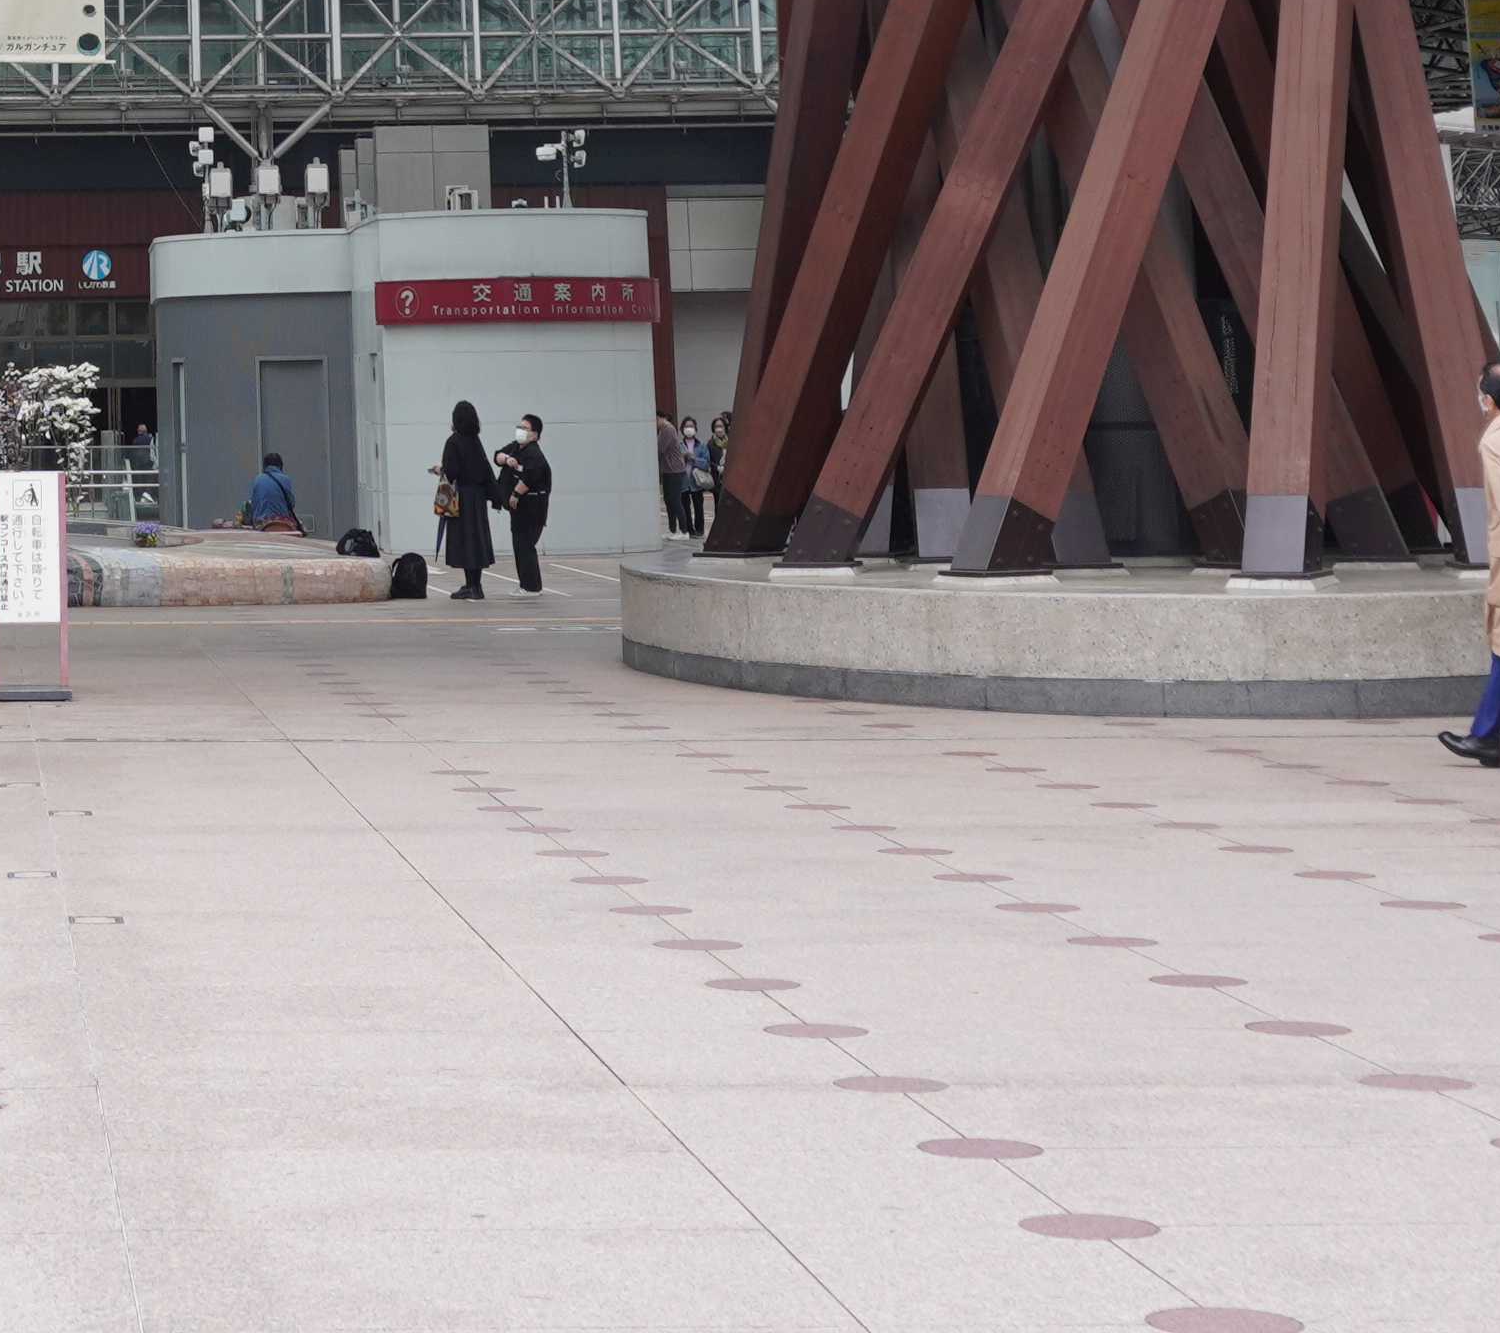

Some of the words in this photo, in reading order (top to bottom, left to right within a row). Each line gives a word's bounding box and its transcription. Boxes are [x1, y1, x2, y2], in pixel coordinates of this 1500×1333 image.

[6, 42, 67, 51] ガルガンチュア
[5, 278, 64, 293] STATION
[472, 283, 635, 302] 交通案内所
[432, 305, 540, 317] Transportation
[551, 305, 624, 315] Information
[12, 514, 24, 606] 通行して下さい。
[31, 514, 43, 600] 自転車は降りて
